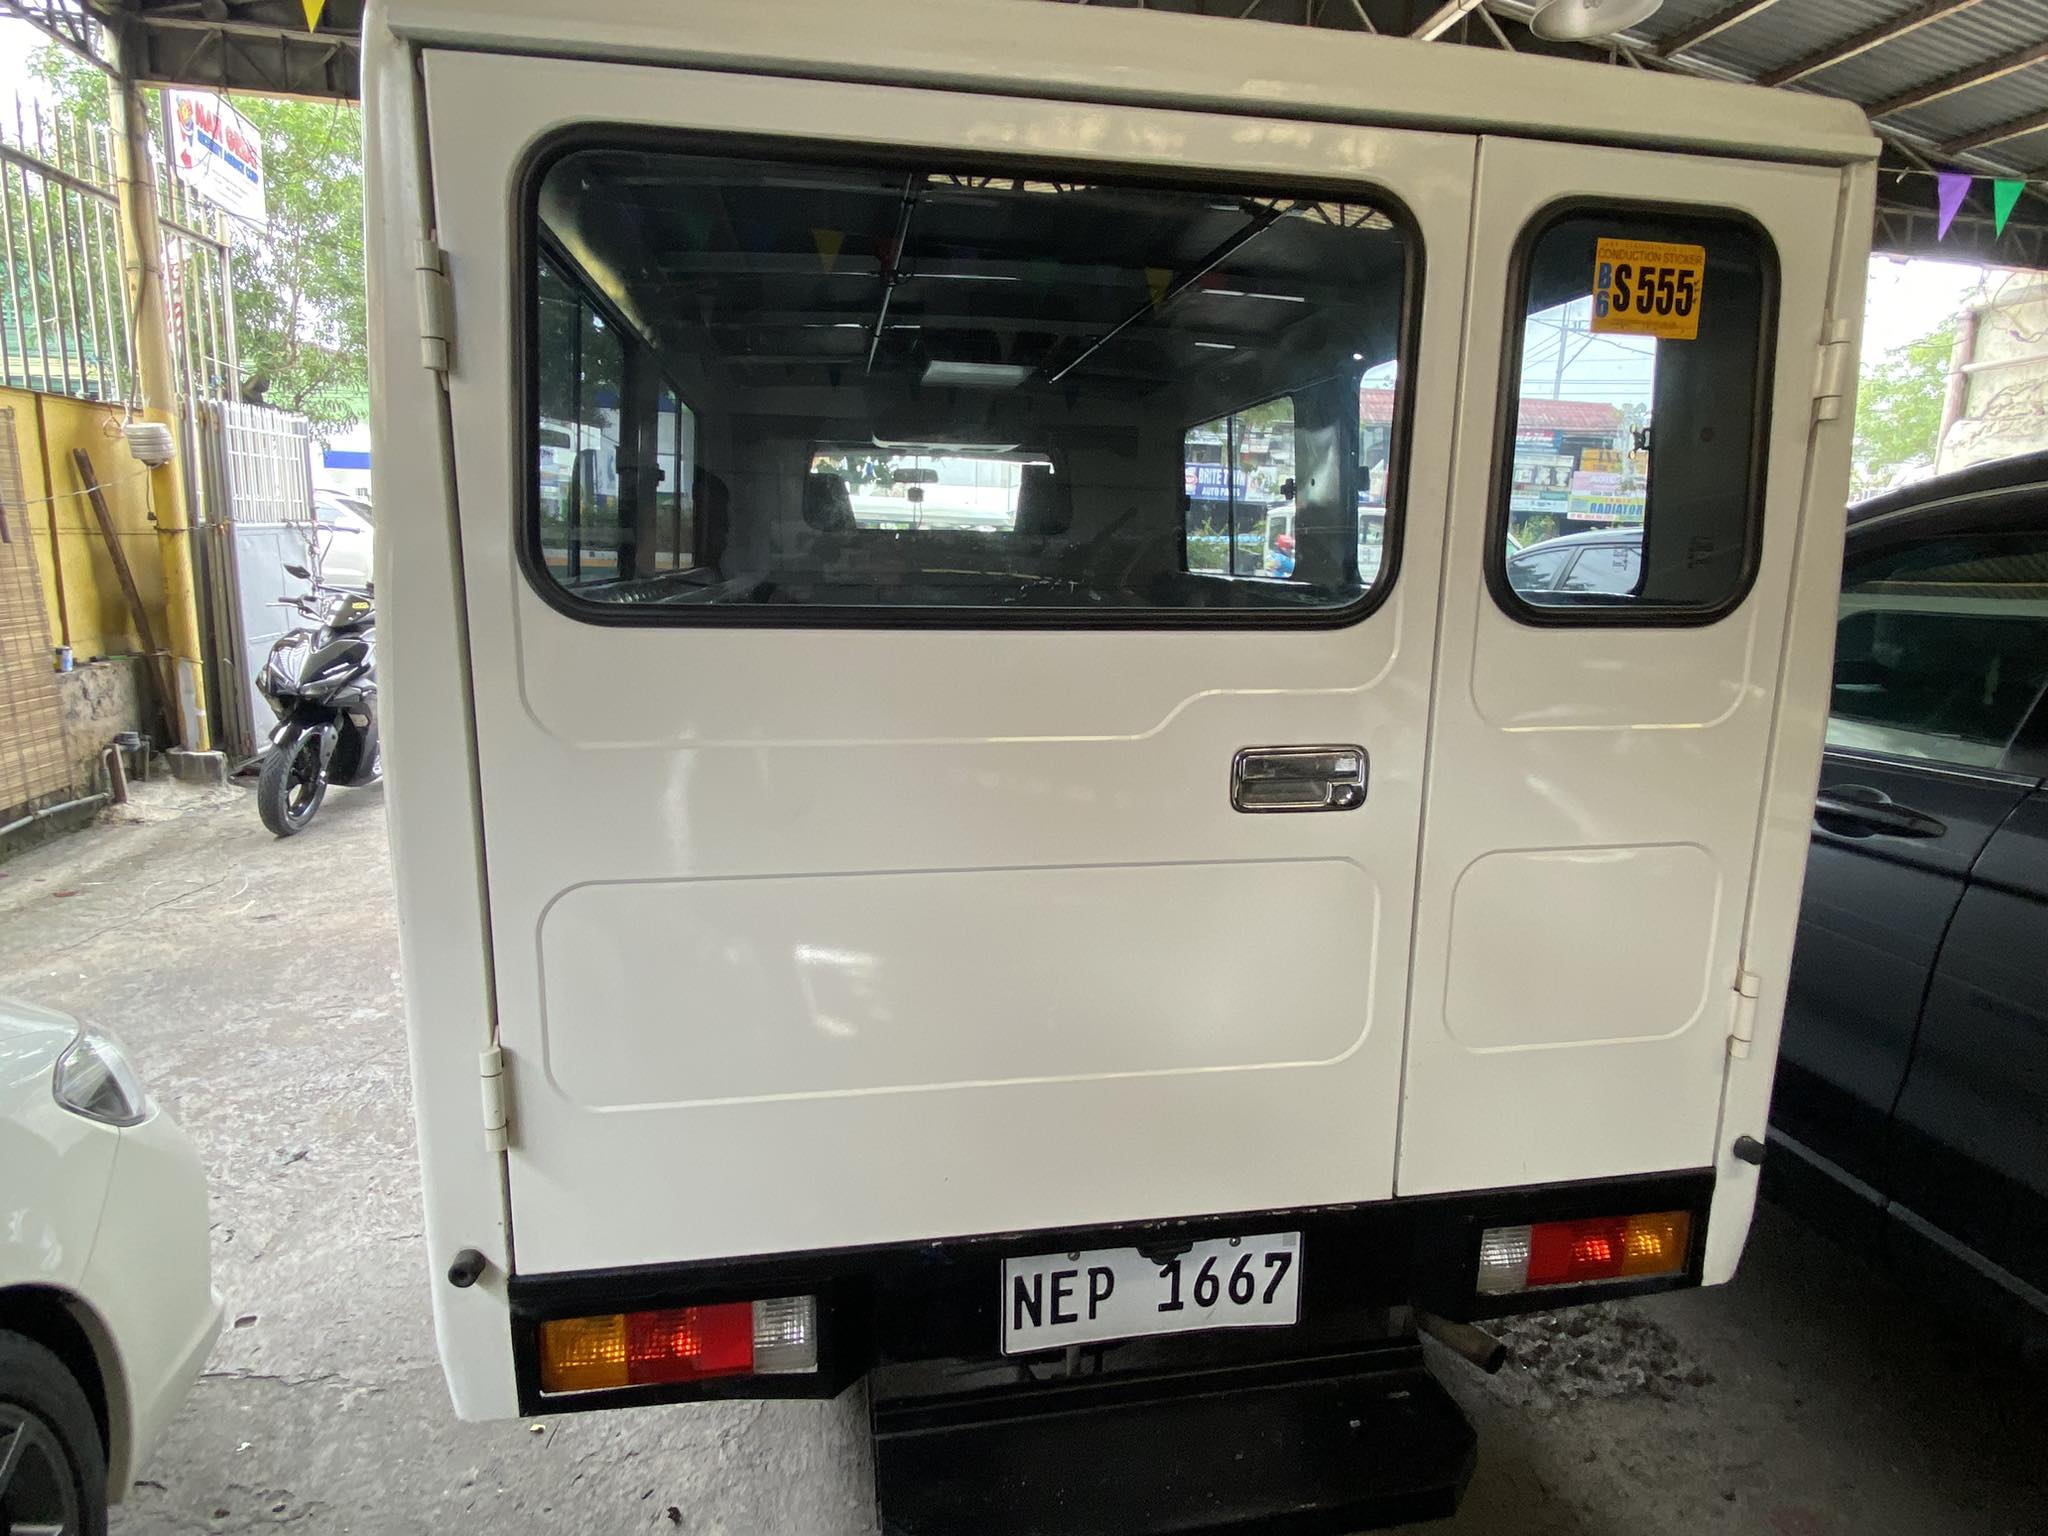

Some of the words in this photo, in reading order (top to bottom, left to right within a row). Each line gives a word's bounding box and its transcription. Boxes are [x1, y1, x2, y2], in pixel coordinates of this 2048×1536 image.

[1598, 247, 1662, 262] CONDUCTION
[1663, 252, 1703, 265] STICKER
[1202, 487, 1219, 497] AUTO
[1220, 487, 1241, 497] PATS
[1590, 502, 1643, 515] RADIATOR
[1013, 1266, 1115, 1330] NEP
[1157, 1252, 1292, 1313] 1667
